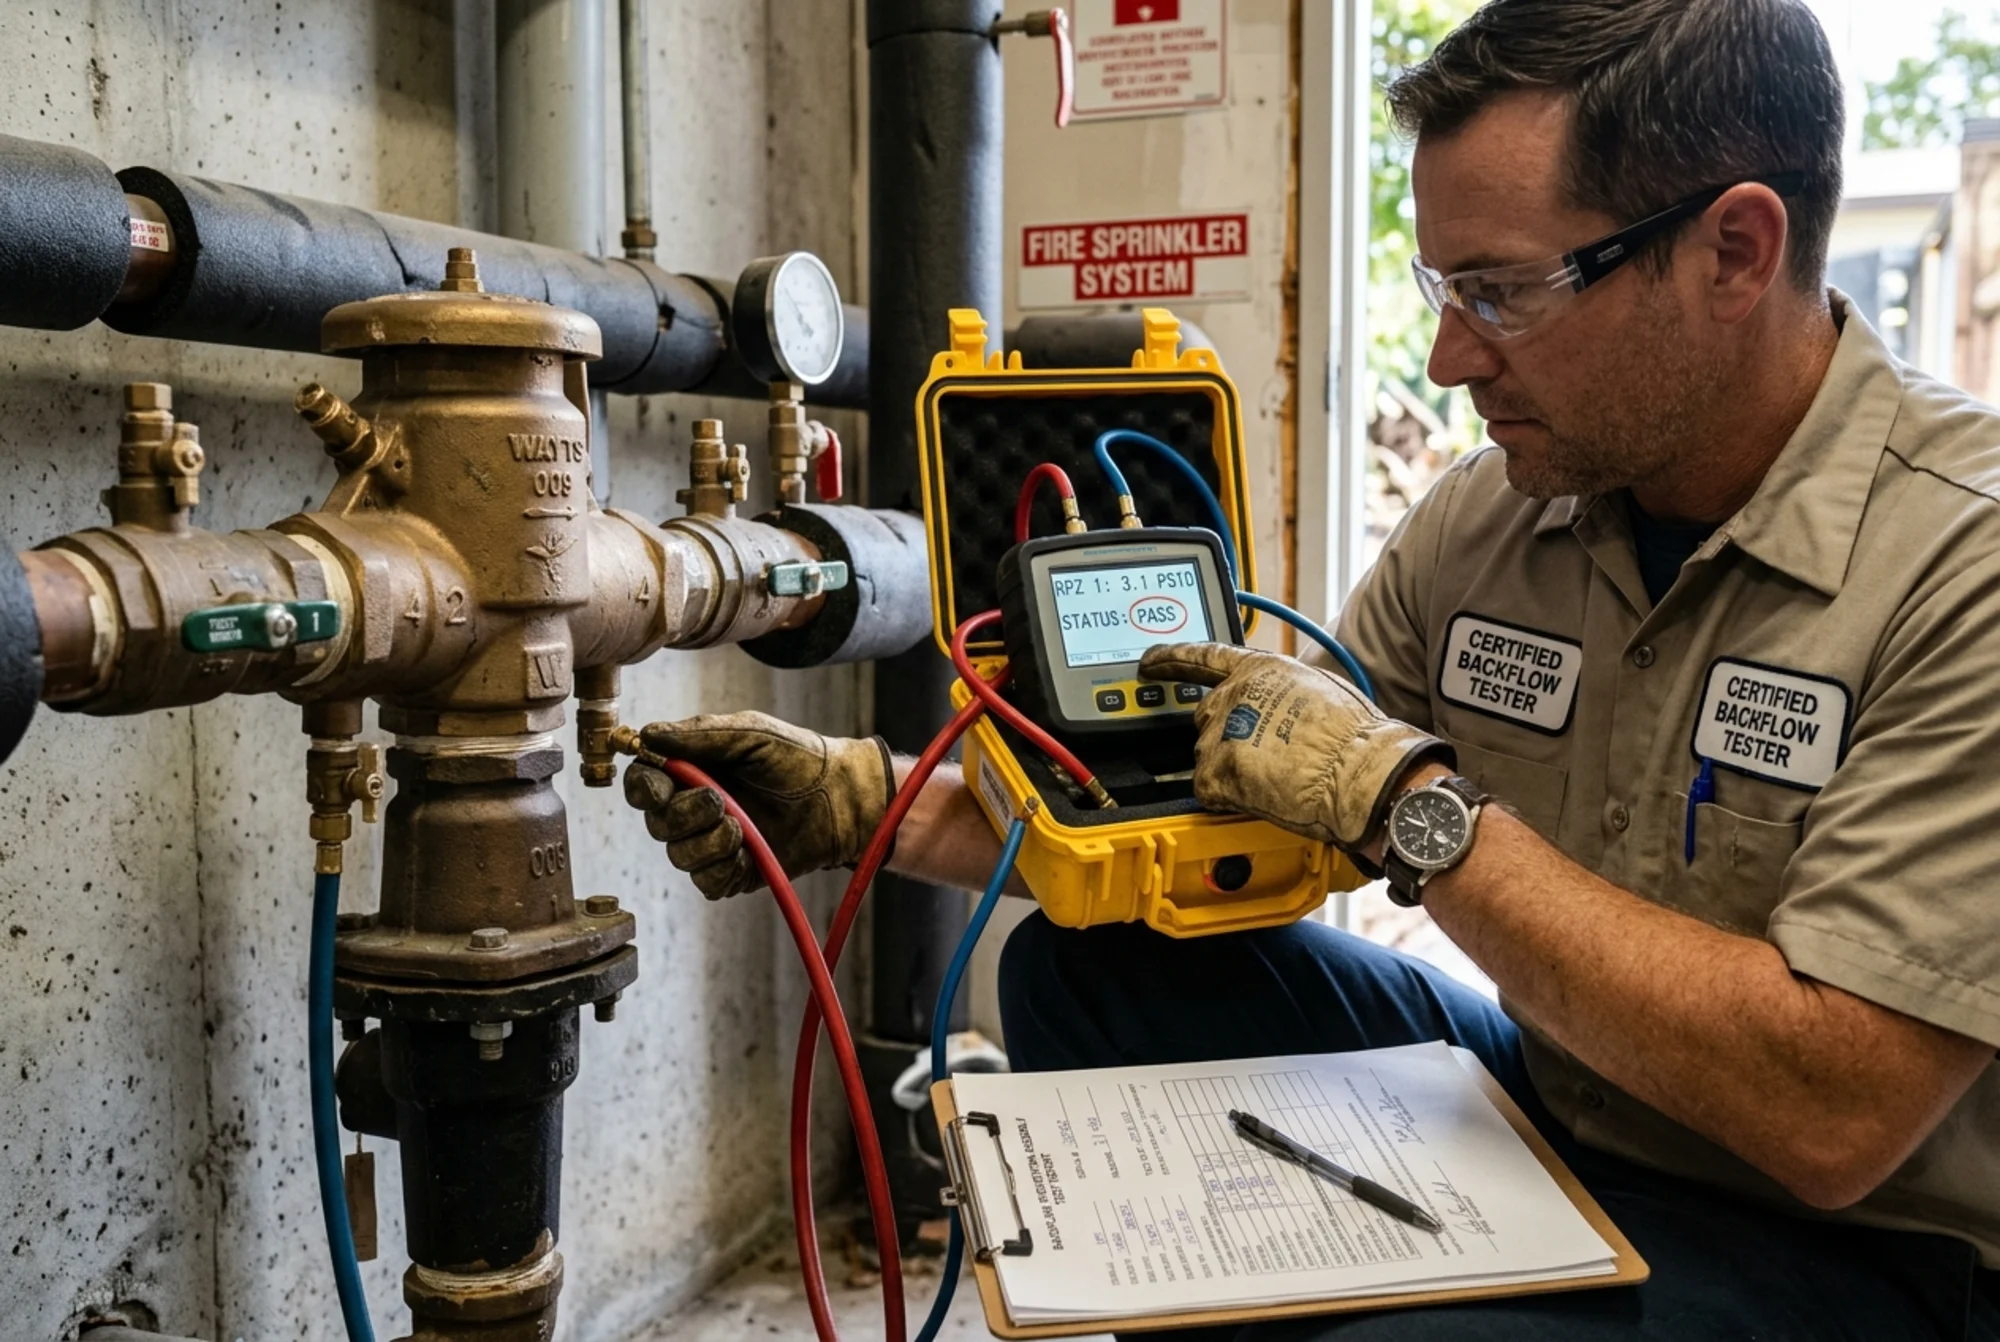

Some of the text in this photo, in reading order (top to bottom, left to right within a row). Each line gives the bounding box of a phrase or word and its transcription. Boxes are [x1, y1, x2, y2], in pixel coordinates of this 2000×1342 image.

[1028, 220, 1242, 262] FIRE SPRINKLER
[1080, 260, 1188, 295] SYSTEM
[507, 433, 584, 463] WATTS
[1054, 578, 1085, 597] RPZ
[1062, 605, 1176, 630] STATUS: PASS
[1468, 629, 1563, 670] CERTIFIED
[1457, 650, 1562, 695] BACKFLOW
[1469, 676, 1538, 714] TESTER
[1727, 676, 1818, 716] CERTIFIED
[1714, 700, 1821, 746] BACKFLOW
[1723, 729, 1791, 768] TESTER
